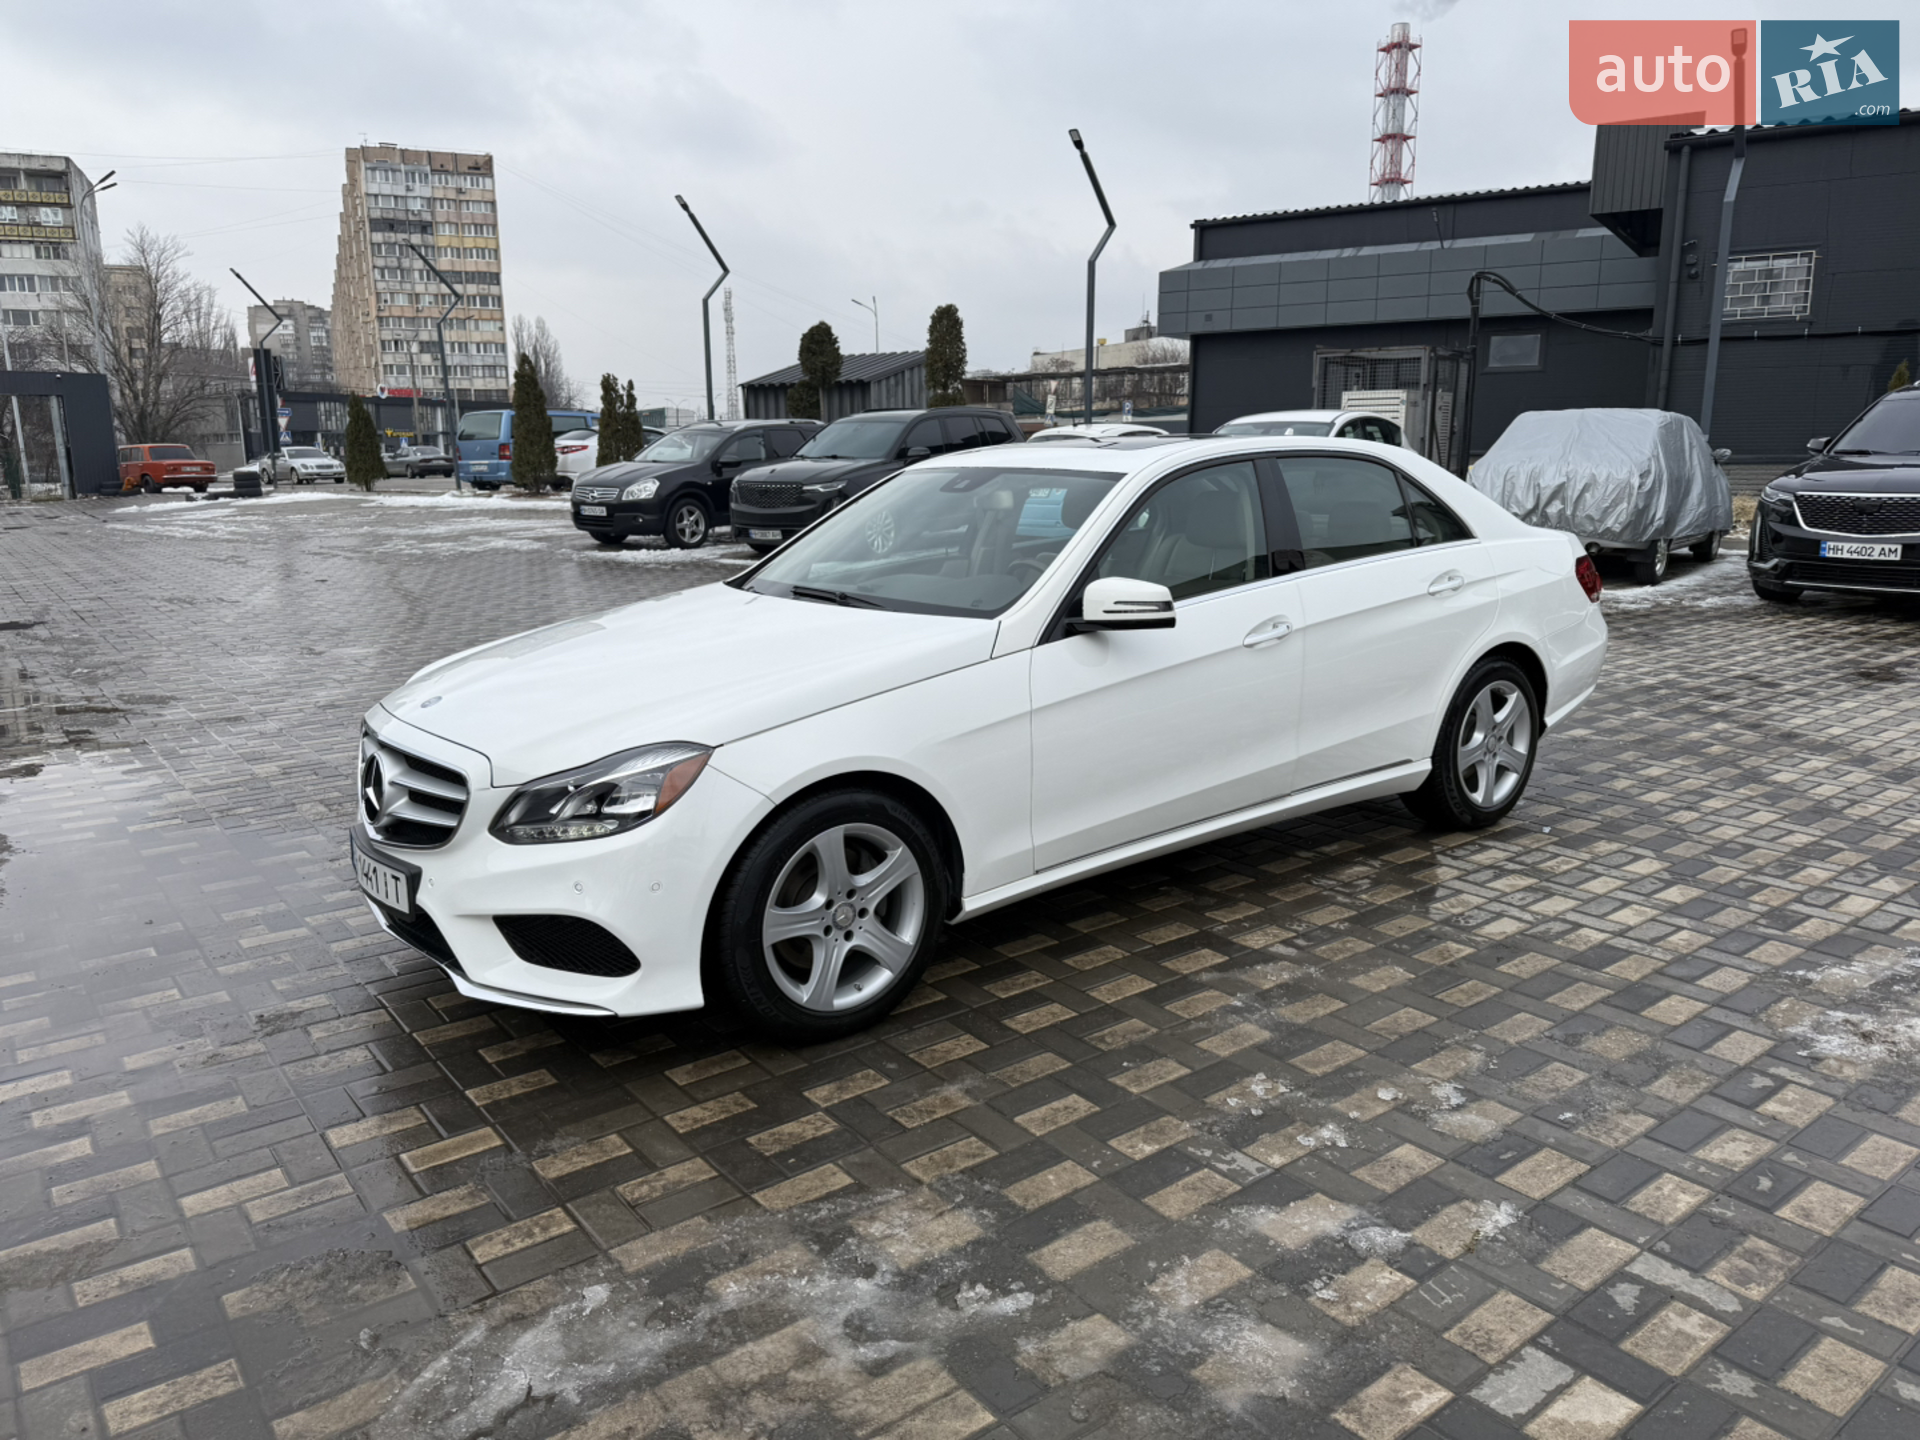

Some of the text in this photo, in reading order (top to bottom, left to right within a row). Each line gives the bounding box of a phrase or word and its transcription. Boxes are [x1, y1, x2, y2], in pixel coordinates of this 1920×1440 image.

[1827, 544, 1899, 558] HH 4402 AM
[383, 870, 401, 904] IT
